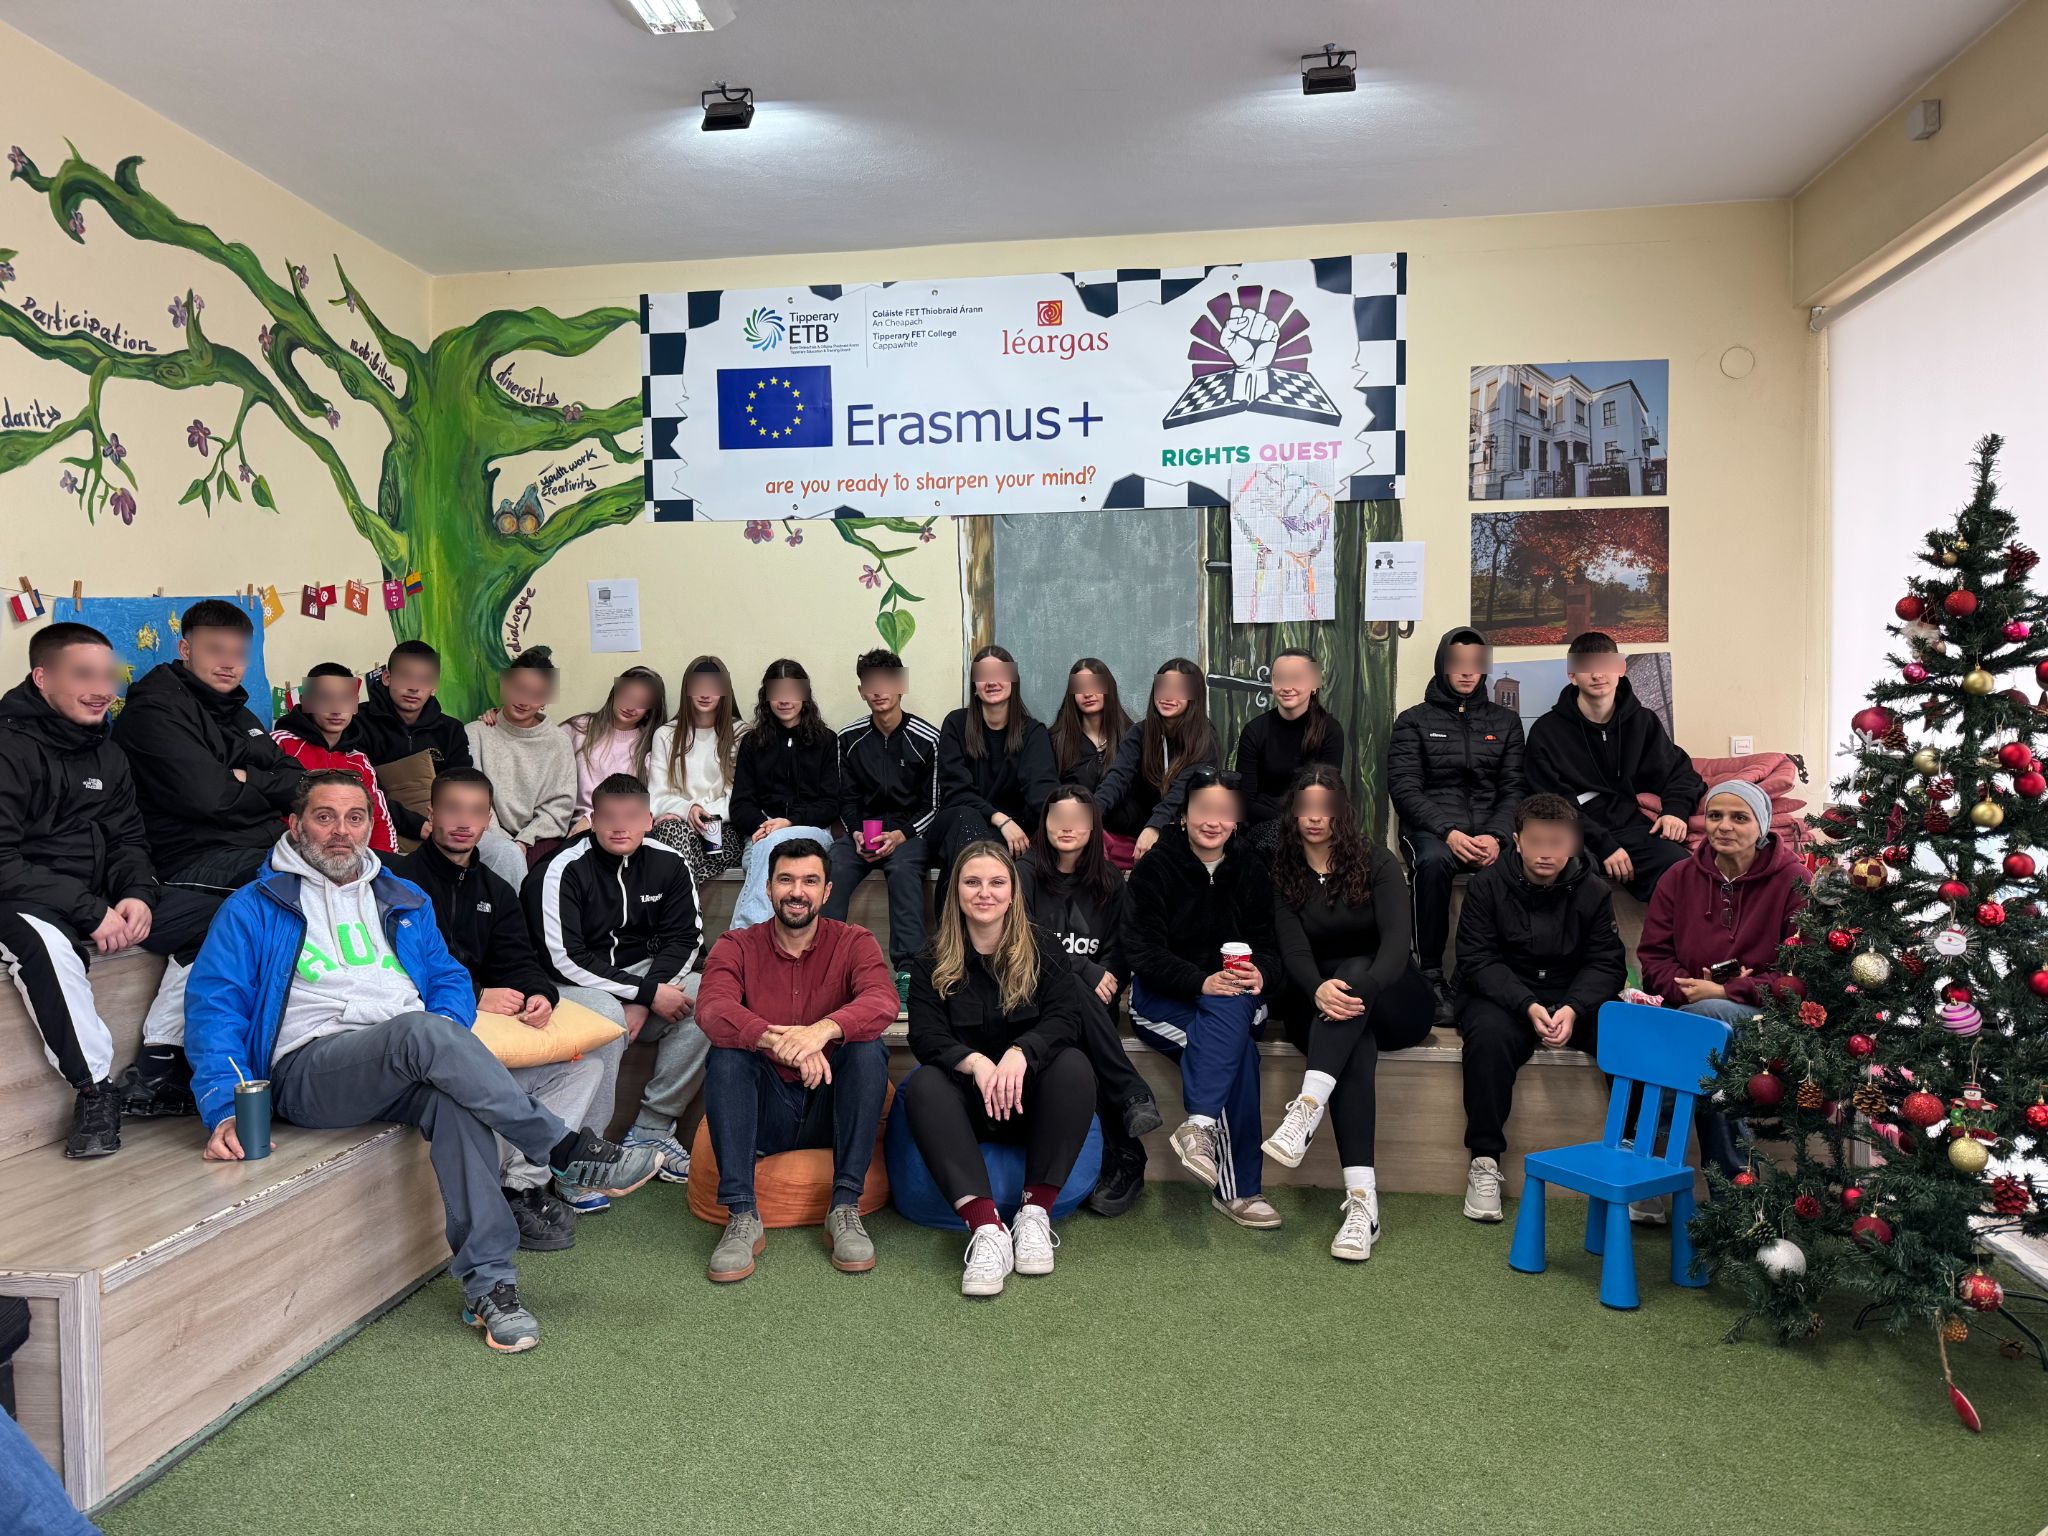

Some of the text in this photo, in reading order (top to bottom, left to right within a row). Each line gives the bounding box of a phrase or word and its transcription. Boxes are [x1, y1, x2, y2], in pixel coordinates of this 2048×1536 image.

[789, 312, 839, 324] Tipperary
[872, 304, 983, 318] Coláiste FET Thiobraid Árann
[885, 318, 923, 327] Cheapach
[789, 324, 829, 344] ETB
[872, 329, 957, 341] Tipperary FET College
[872, 340, 918, 350] Cappawhite
[1002, 329, 1109, 360] léargas
[496, 362, 560, 407] diversity
[847, 401, 1103, 446] Erasmus+
[569, 448, 598, 472] work
[1161, 440, 1342, 467] RIGHTS QUEST
[765, 465, 1097, 499] are you ready to sharpen your mind?
